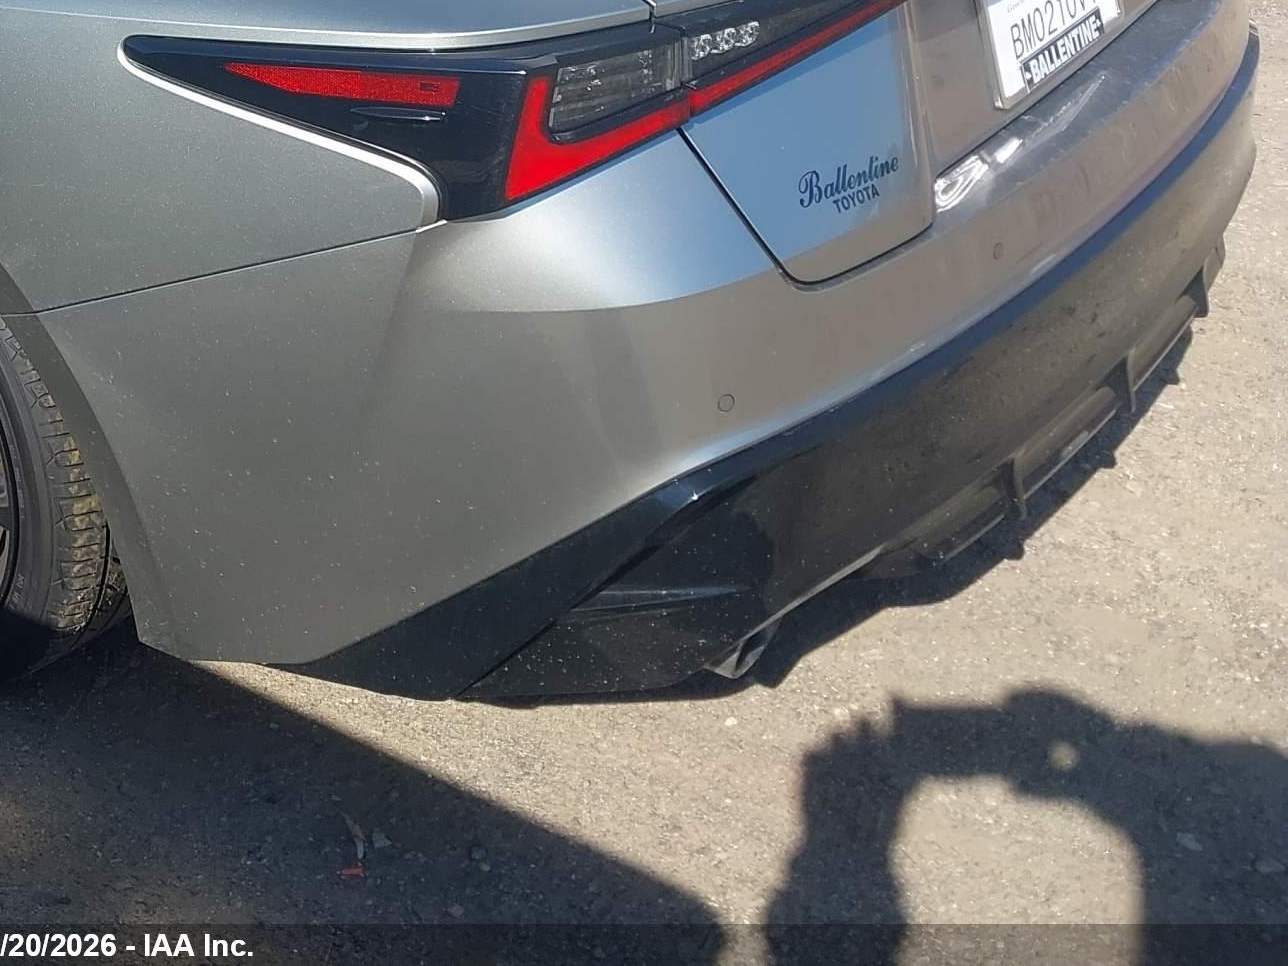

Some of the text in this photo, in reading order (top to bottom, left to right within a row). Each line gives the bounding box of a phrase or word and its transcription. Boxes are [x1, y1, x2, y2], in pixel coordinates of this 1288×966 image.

[1028, 14, 1101, 84] BALLENTINE
[798, 155, 899, 208] Ballentine
[832, 184, 881, 214] TOYOTA
